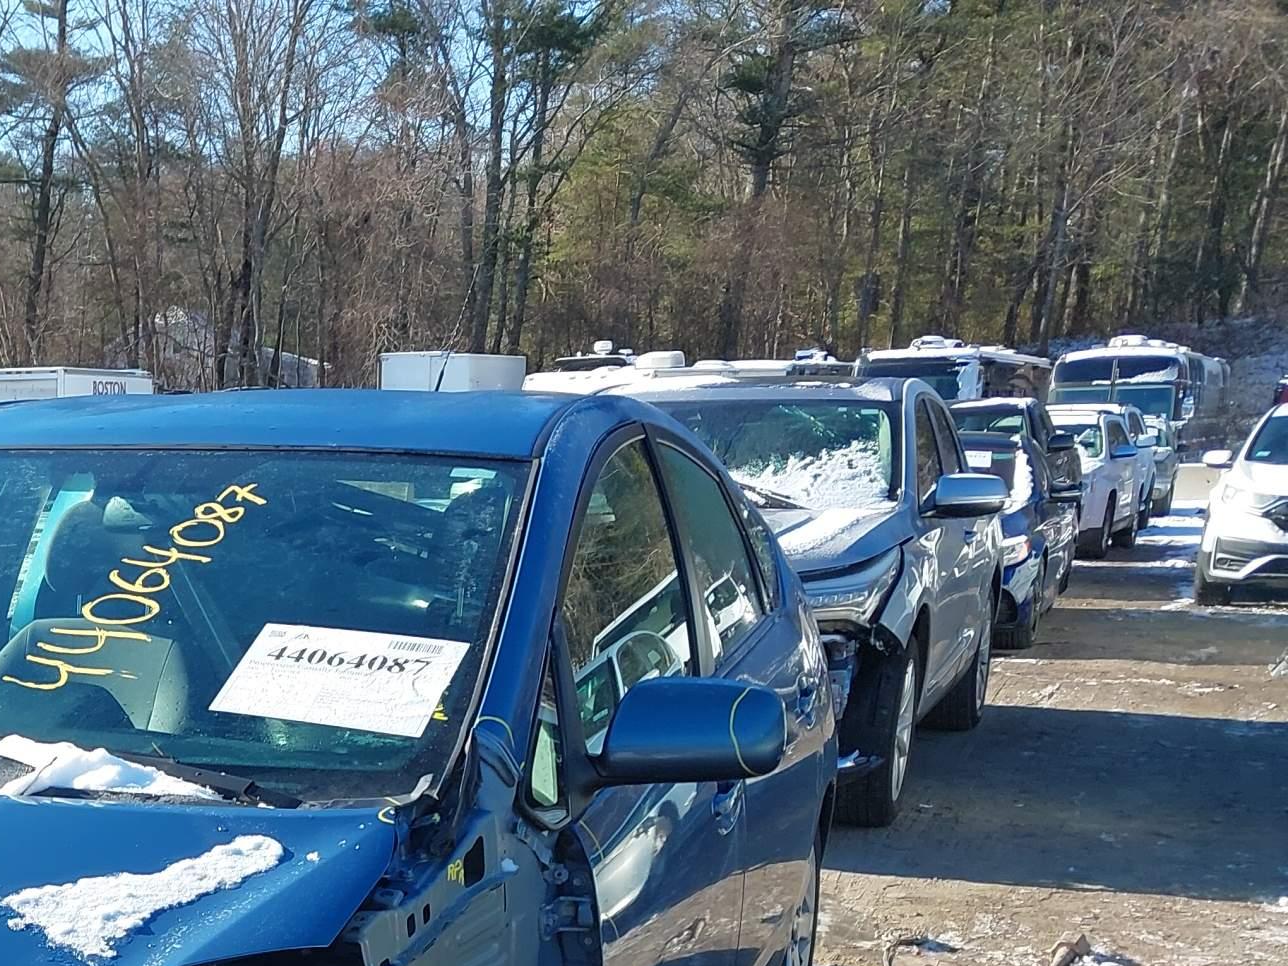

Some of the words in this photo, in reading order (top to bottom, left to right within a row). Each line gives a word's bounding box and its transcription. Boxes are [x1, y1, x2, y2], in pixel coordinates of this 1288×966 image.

[92, 380, 127, 396] BOSTON
[2, 483, 267, 691] 44064087
[267, 646, 434, 676] 44064087
